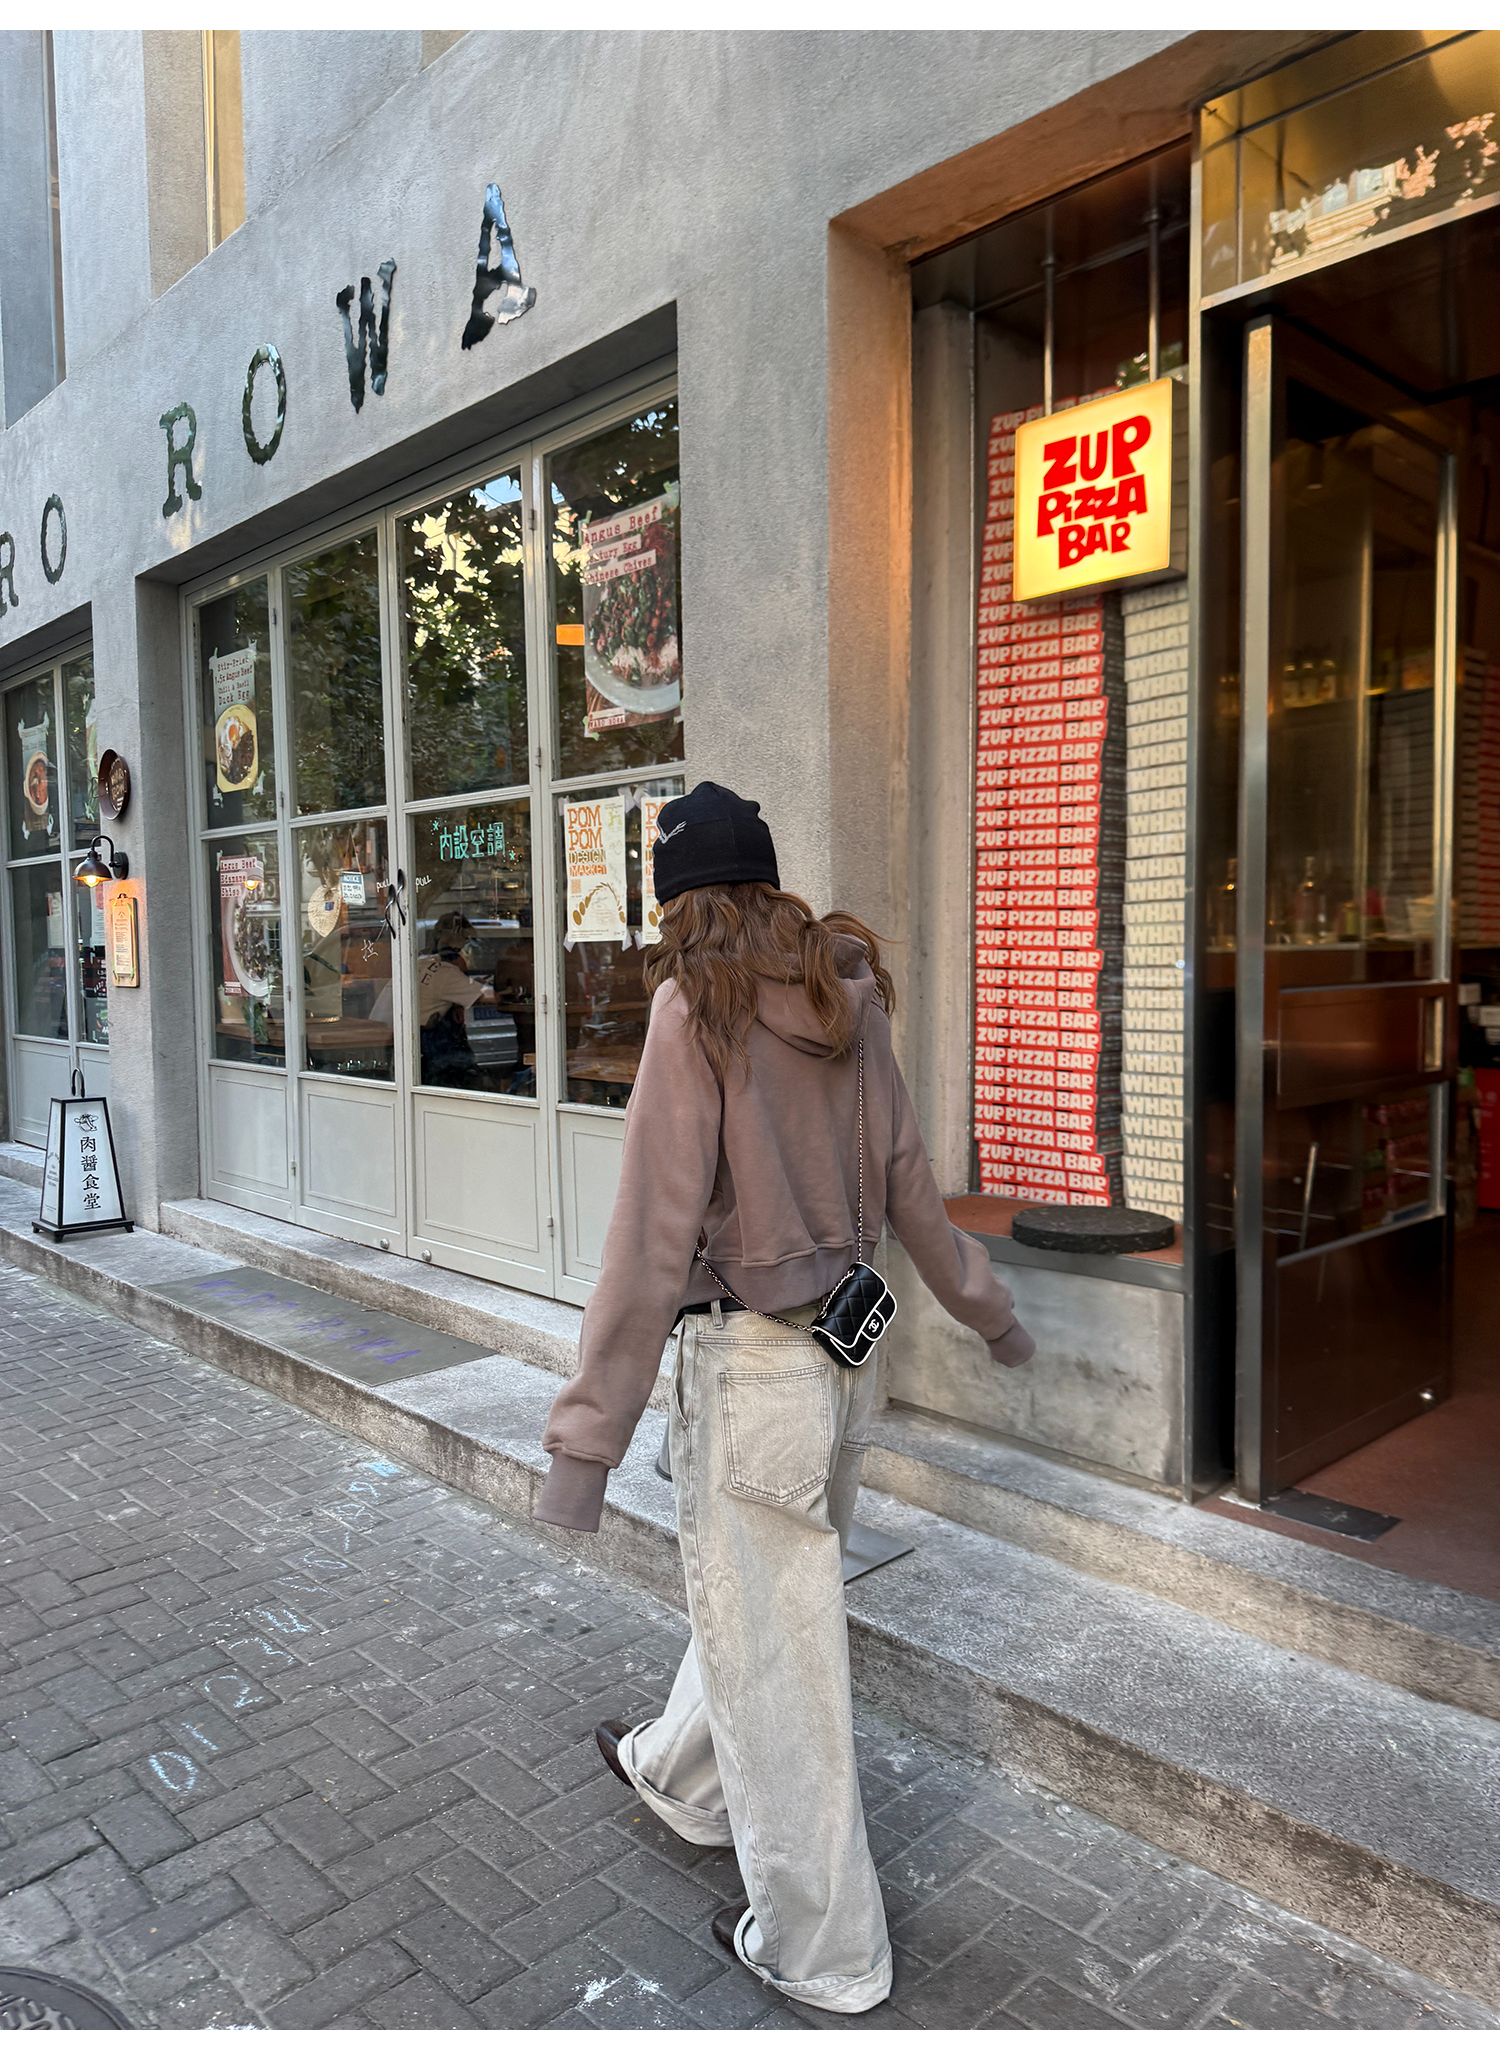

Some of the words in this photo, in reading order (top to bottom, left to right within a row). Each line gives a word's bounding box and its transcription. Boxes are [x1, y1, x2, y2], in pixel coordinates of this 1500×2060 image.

[159, 183, 537, 518] ROWA
[1043, 415, 1152, 491] ZUP
[584, 524, 620, 544] Angus
[629, 506, 658, 530] Beef
[1058, 521, 1132, 570] BAR
[624, 557, 652, 573] Chives
[978, 626, 1009, 645] ZUP
[1011, 620, 1058, 639] PIZZA
[979, 646, 1010, 665] ZUP
[1012, 640, 1059, 660] PIZZA
[978, 667, 1009, 685] ZUP
[1011, 662, 1059, 681] PIZZA
[978, 688, 1009, 706] ZUP
[1011, 683, 1058, 702] PIZZA
[981, 708, 1012, 725] ZUP
[1014, 704, 1063, 722] PIZZA
[980, 728, 1012, 746] ZUP
[1014, 724, 1062, 742] PIZZA
[976, 750, 1008, 767] ZUP
[1010, 746, 1058, 764] PIZZA
[976, 770, 1008, 787] ZUP
[1010, 767, 1058, 784] PIZZA
[976, 790, 1007, 807] ZUP
[1009, 788, 1056, 804] PIZZA
[567, 805, 602, 829] POM
[976, 810, 1007, 827] ZUP
[1009, 808, 1057, 824] PIZZA
[568, 827, 603, 850] POM
[976, 830, 1006, 847] ZUP
[1008, 829, 1056, 845] PIZZA
[569, 849, 606, 864] DESIGN
[976, 851, 1008, 867] ZUP
[1010, 850, 1056, 865] PIZZA
[570, 864, 607, 877] MARKET
[976, 871, 1007, 886] ZUP
[1009, 870, 1056, 885] PIZZA
[974, 890, 1005, 906] ZUP
[1007, 891, 1054, 905] PIZZA
[976, 910, 1006, 925] ZUP
[1008, 910, 1056, 926] PIZZA
[974, 930, 1005, 945] ZUP
[1007, 930, 1054, 946] PIZZA
[978, 950, 1009, 965] ZUP
[1011, 950, 1059, 966] PIZZA
[975, 969, 1006, 984] ZUP
[1008, 970, 1055, 986] PIZZA
[975, 988, 1006, 1003] ZUP
[1008, 989, 1055, 1006] PIZZA
[977, 1008, 1008, 1023] ZUP
[1010, 1009, 1058, 1026] PIZZA
[977, 1028, 1008, 1043] ZUP
[1010, 1029, 1058, 1046] PIZZA
[974, 1047, 1006, 1063] ZUP
[1008, 1048, 1054, 1066] PIZZA
[974, 1066, 1004, 1081] ZUP
[1006, 1068, 1054, 1086] PIZZA
[974, 1085, 1005, 1101] ZUP
[1007, 1087, 1054, 1106] PIZZA
[973, 1104, 1004, 1121] ZUP
[1006, 1107, 1053, 1126] PIZZA
[974, 1124, 1005, 1140] ZUP
[1007, 1126, 1054, 1146] PIZZA
[981, 1144, 1012, 1161] ZUP
[1014, 1146, 1062, 1167] PIZZA
[80, 1136, 101, 1211] 肉醬食堂
[984, 1163, 1014, 1180] ZUP
[1016, 1166, 1066, 1186] PIZZA
